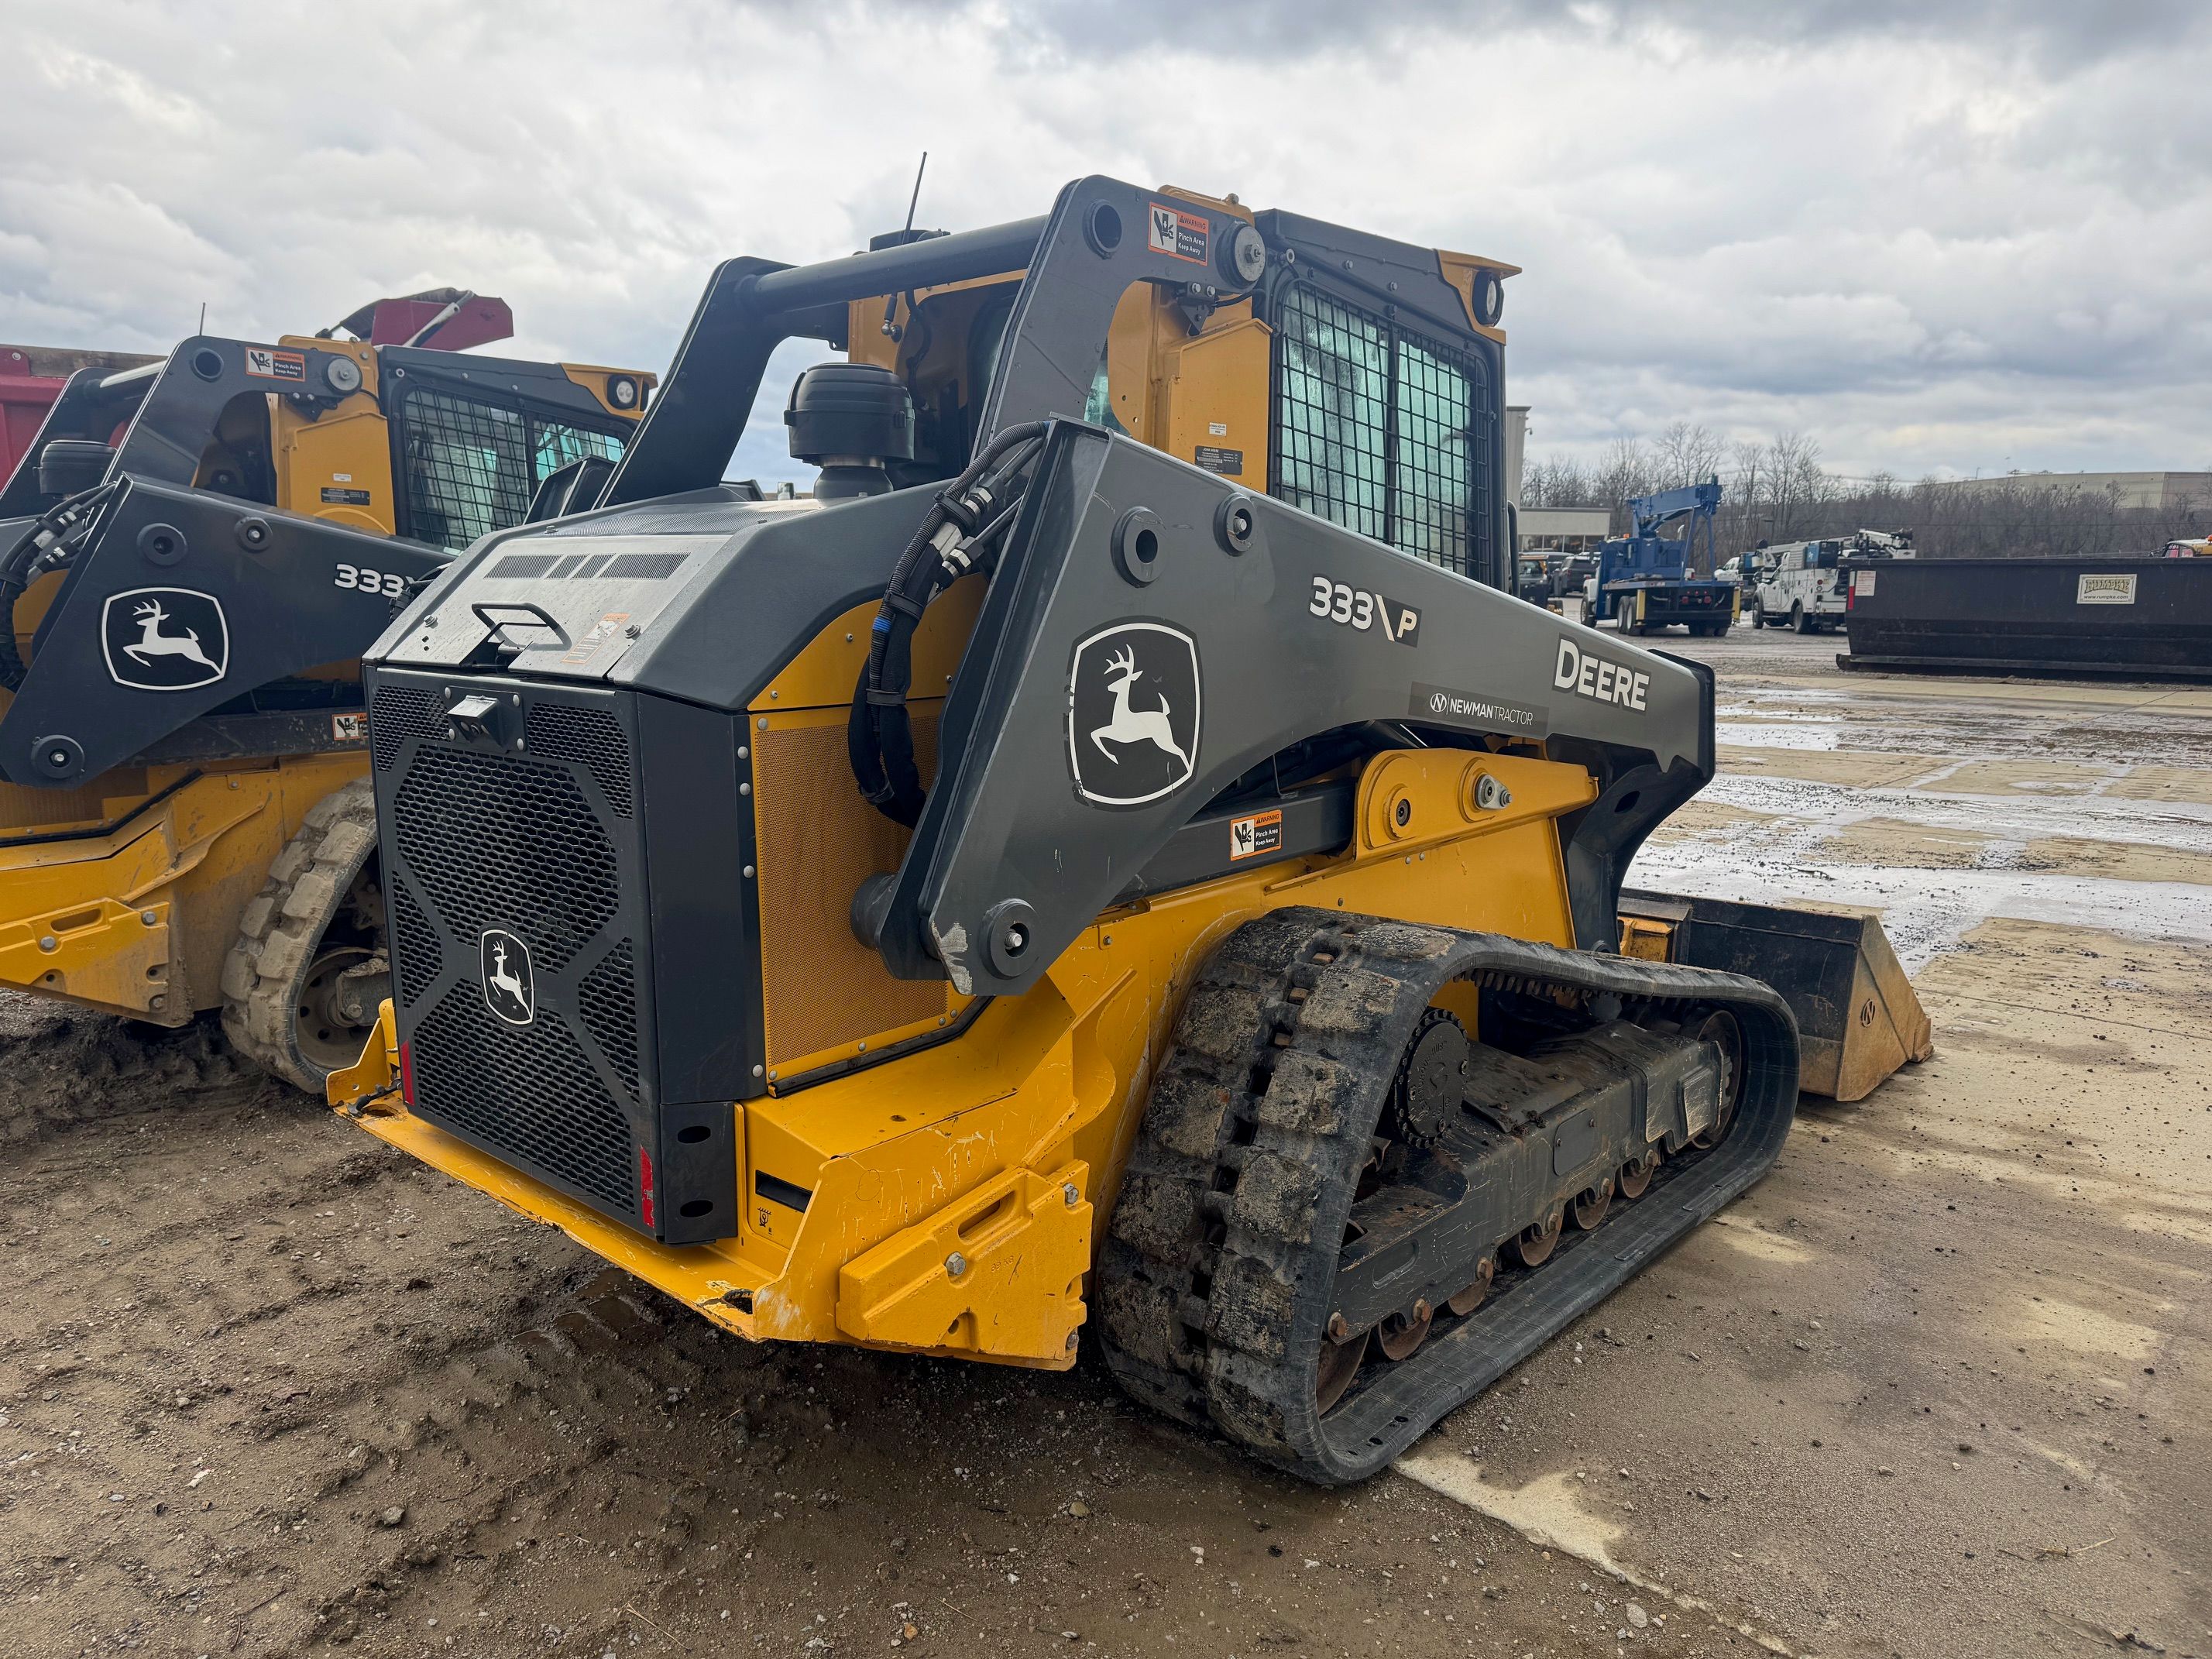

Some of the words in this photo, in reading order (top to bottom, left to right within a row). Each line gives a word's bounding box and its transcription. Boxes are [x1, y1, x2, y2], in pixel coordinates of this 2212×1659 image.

[1184, 217, 1206, 230] WARNING
[1178, 232, 1192, 242] Pinch
[1193, 237, 1204, 246] Area
[1178, 242, 1189, 251] Keep
[1189, 246, 1201, 255] Away
[335, 563, 404, 599] 333
[2084, 579, 2130, 594] RUMPKE
[1554, 638, 1650, 711] DEERE
[1261, 813, 1279, 823] WARNING
[1255, 830, 1268, 839] Pinch
